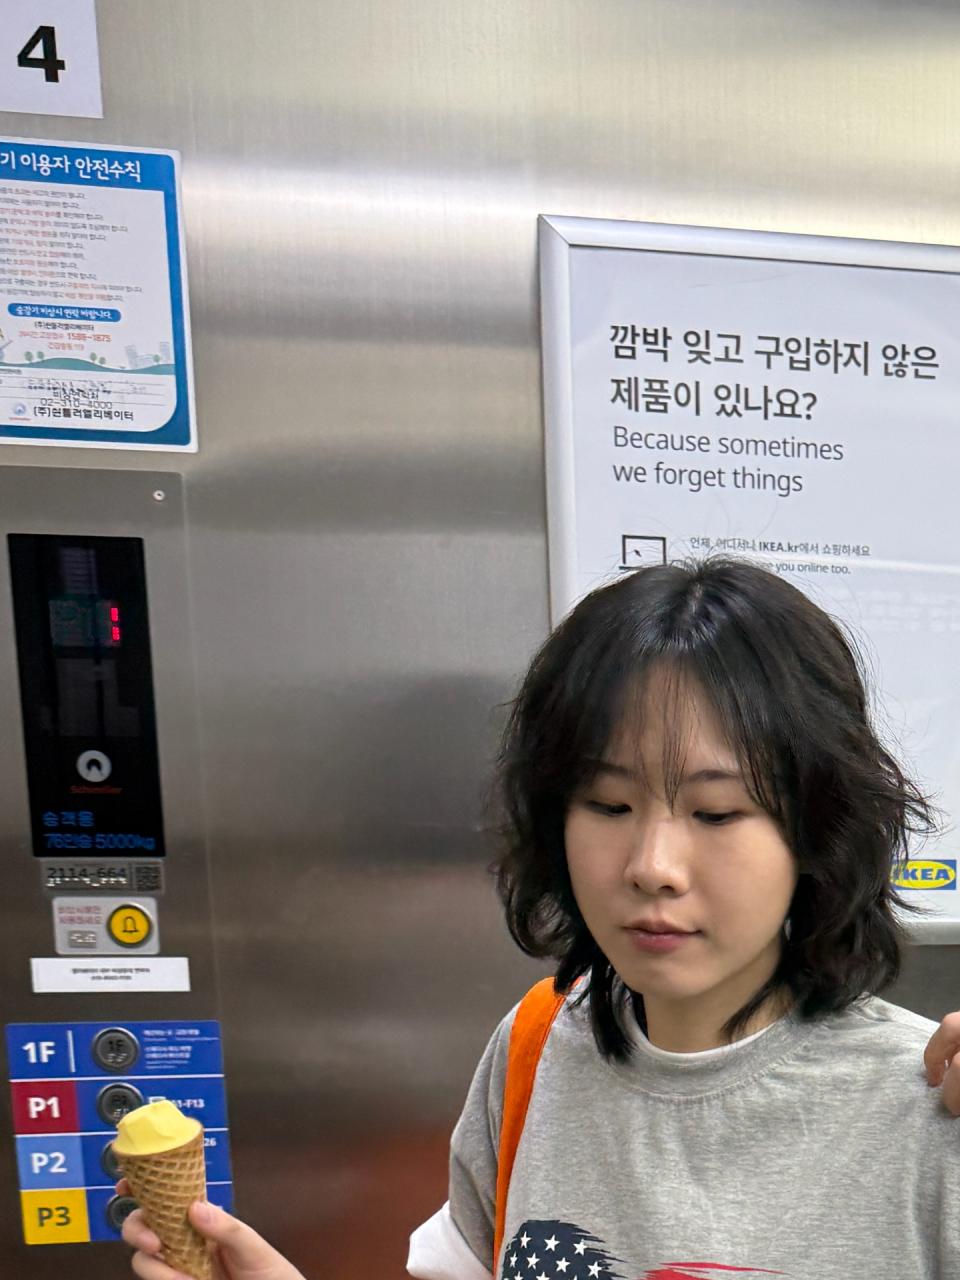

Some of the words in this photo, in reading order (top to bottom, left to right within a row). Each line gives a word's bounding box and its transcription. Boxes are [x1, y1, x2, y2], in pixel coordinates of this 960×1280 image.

[17, 25, 65, 83] 4
[20, 152, 71, 176] 이용자
[75, 156, 141, 183] 안전수칙
[609, 324, 672, 362] 깜박
[683, 329, 744, 364] 잊고
[754, 335, 869, 376] 구입하지
[881, 344, 940, 380] 않은
[610, 376, 700, 416] 제품이
[713, 383, 818, 420] 있나요?
[613, 425, 710, 453] Because
[718, 436, 844, 460] sometimes
[613, 465, 647, 483] we
[654, 462, 726, 492] forget
[733, 467, 803, 497] things
[759, 541, 820, 556] IKEA.kr에서
[823, 544, 870, 556] 쇼핑하세요
[775, 562, 795, 574] you
[797, 563, 829, 574] online
[831, 564, 851, 575] too.
[47, 867, 127, 878] 2114-664
[22, 1041, 56, 1063] 1F
[28, 1096, 61, 1119] P1
[31, 1153, 67, 1174] P2
[37, 1206, 71, 1227] P3
